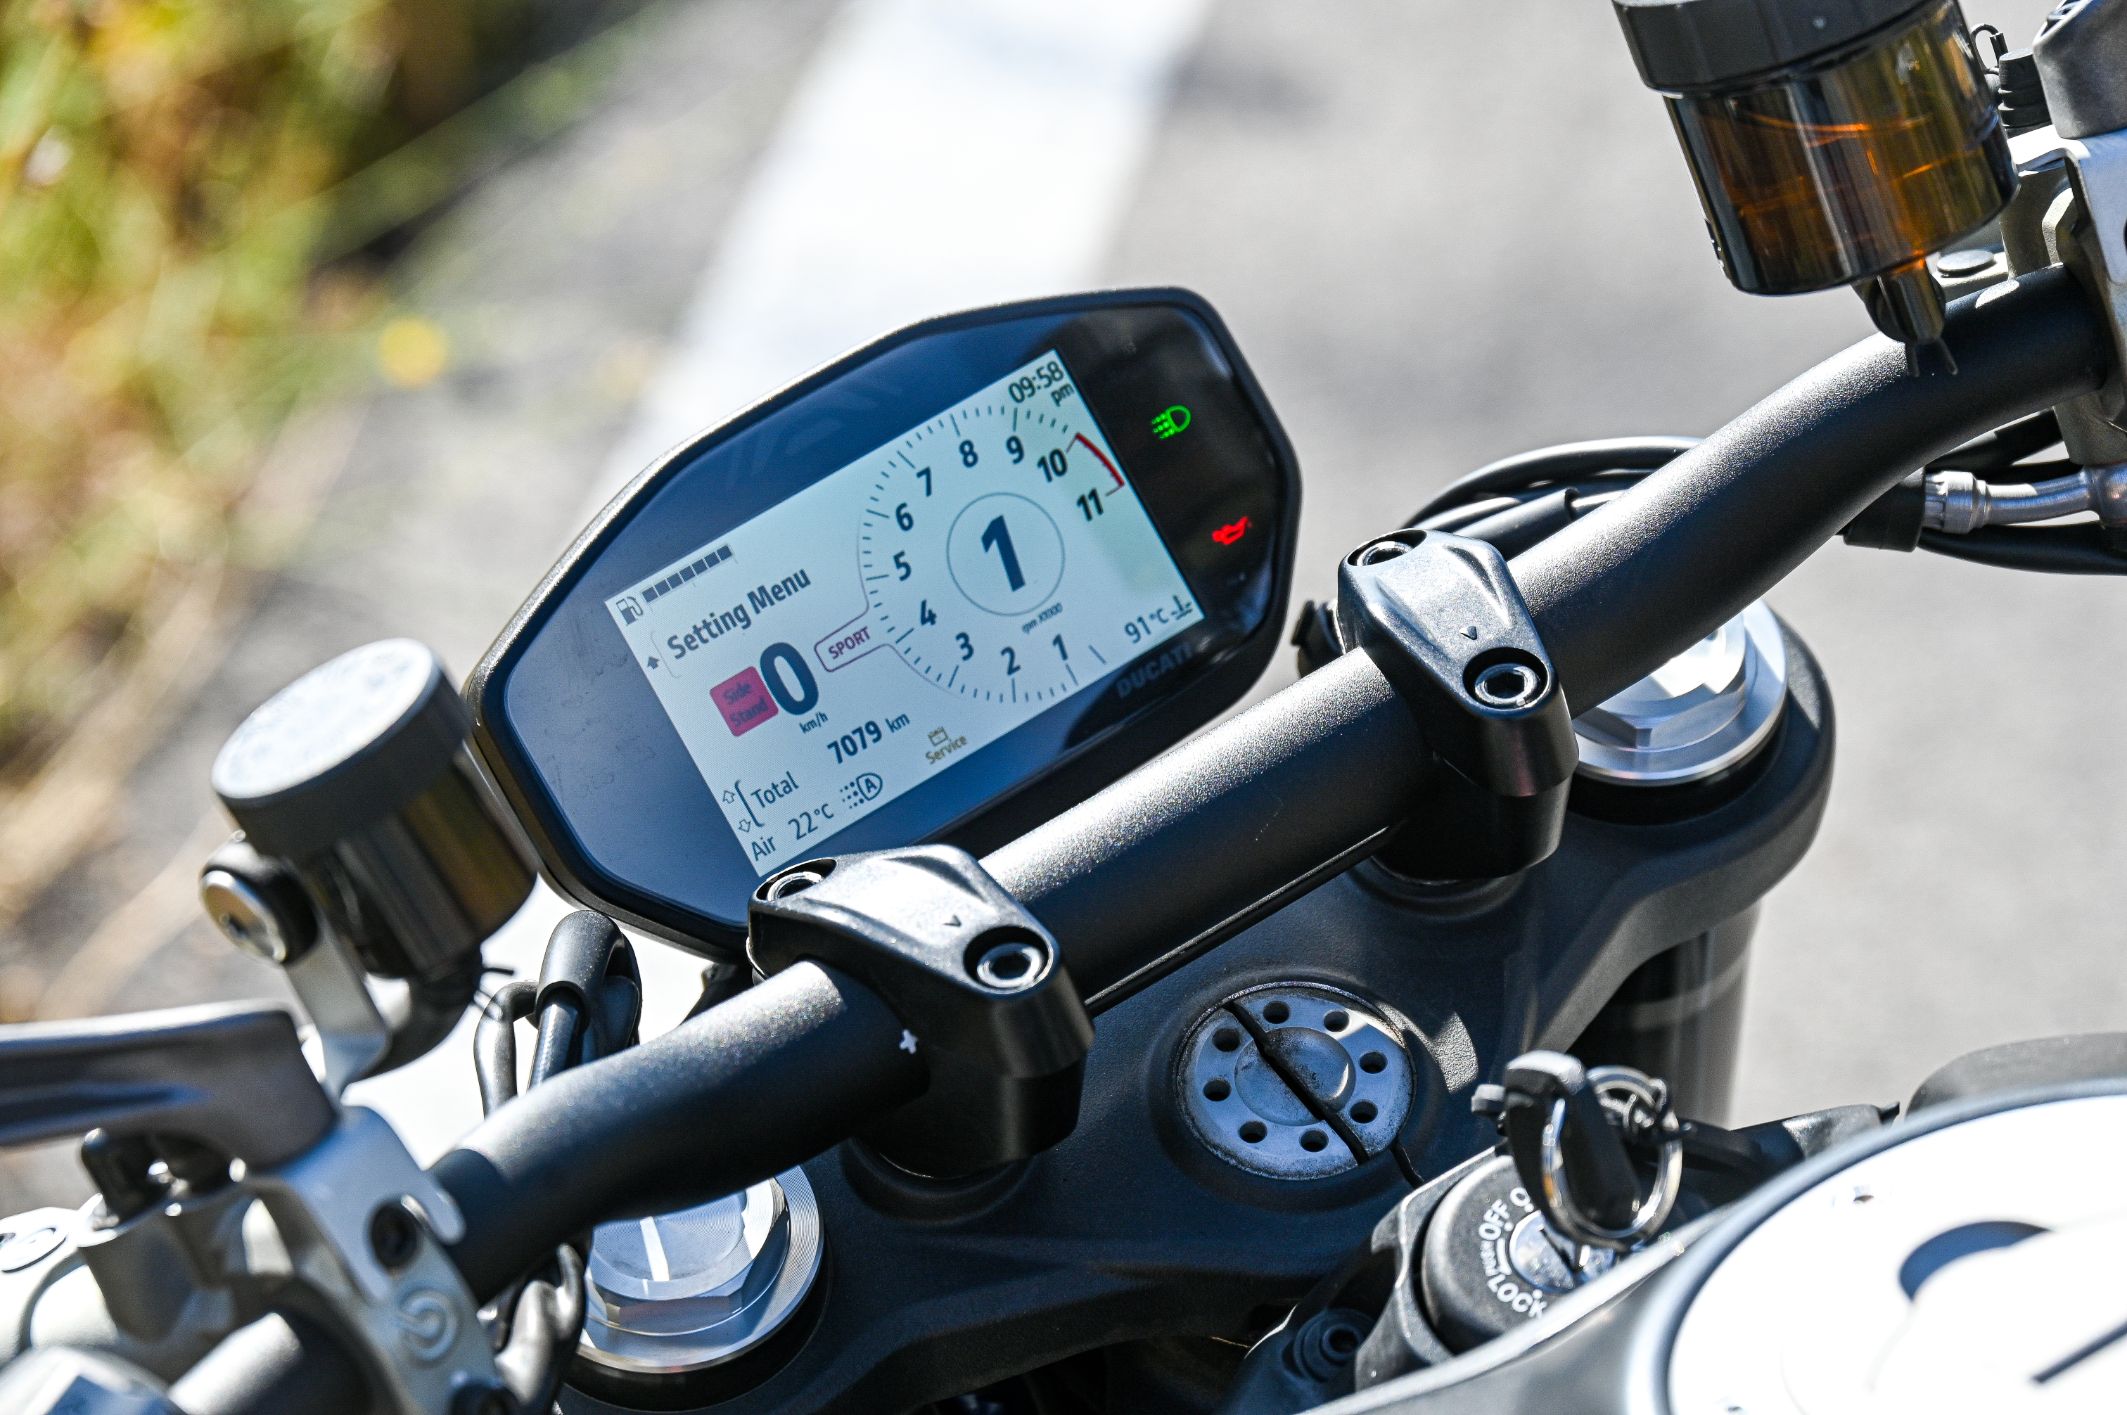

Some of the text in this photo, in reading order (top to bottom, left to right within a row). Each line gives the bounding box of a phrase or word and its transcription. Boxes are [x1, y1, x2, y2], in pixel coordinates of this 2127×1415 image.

[1008, 360, 1065, 403] 09:58
[1050, 383, 1075, 407] pm
[959, 439, 979, 468] 8
[1006, 435, 1025, 464] 9
[1037, 448, 1068, 483] 10
[917, 467, 933, 497] 7
[895, 502, 914, 532] 6
[1076, 488, 1105, 522] 11
[893, 551, 912, 581] 5
[981, 515, 1026, 592] 1
[667, 568, 812, 660] Setting Menu
[920, 599, 937, 626] 4
[828, 626, 872, 660] SPORT
[955, 631, 974, 662] 3
[1052, 634, 1069, 661] 1
[1000, 646, 1021, 676] 2
[1117, 642, 1193, 699] DUCATI
[723, 681, 752, 705] Side
[759, 642, 819, 715] 0
[730, 695, 768, 728] Stand
[799, 711, 829, 735] km/h
[827, 713, 910, 764] 7079 km
[925, 735, 967, 764] Service
[751, 771, 800, 808] Total
[751, 835, 777, 861] Air
[1478, 1199, 1510, 1241] OFF
[1487, 1273, 1547, 1319] LOCK
